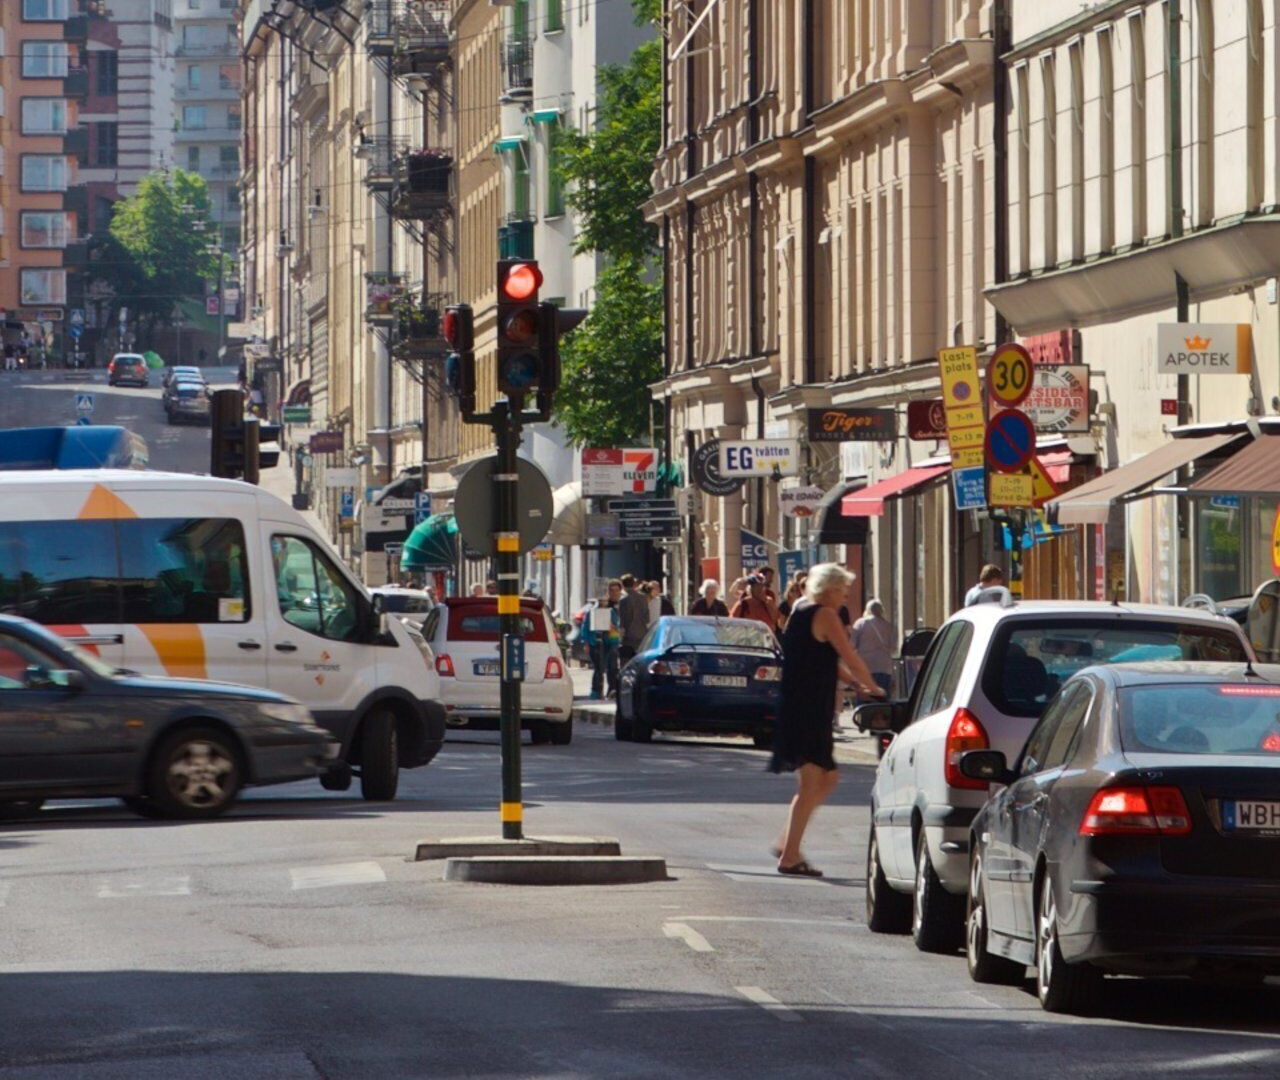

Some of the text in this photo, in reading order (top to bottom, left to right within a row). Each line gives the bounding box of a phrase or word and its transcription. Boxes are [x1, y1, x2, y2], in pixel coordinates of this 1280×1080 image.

[945, 362, 973, 374] plats
[1165, 352, 1230, 366] APOTEK
[995, 359, 1026, 391] 30
[823, 411, 873, 432] Tiger
[726, 446, 790, 470] EG tvätten
[623, 452, 654, 494] 7
[741, 544, 768, 558] EG
